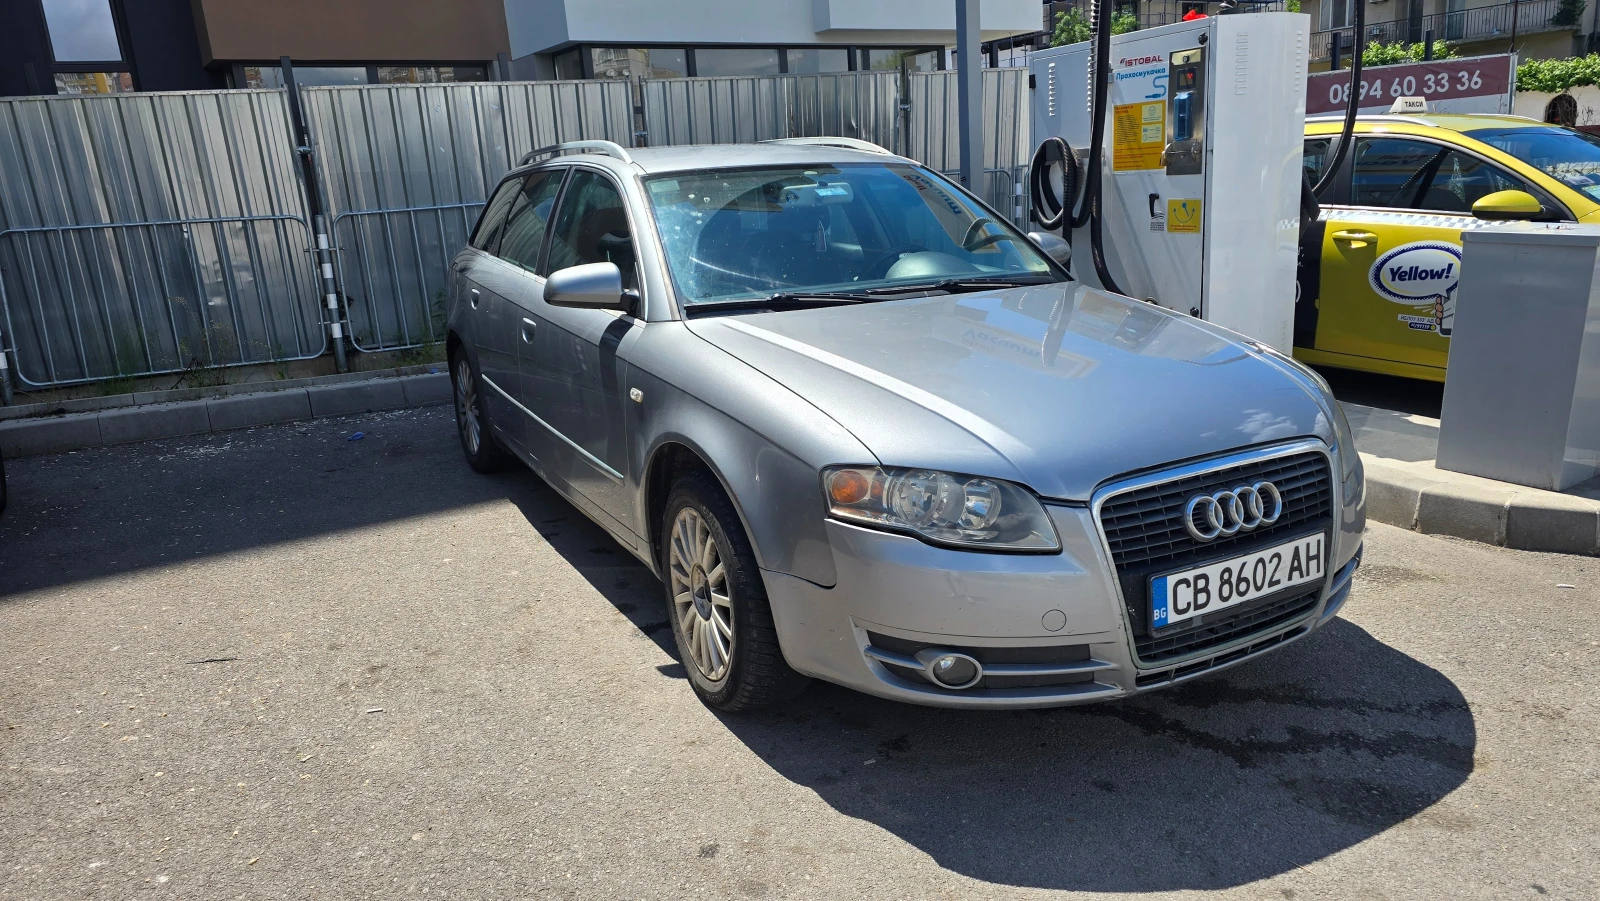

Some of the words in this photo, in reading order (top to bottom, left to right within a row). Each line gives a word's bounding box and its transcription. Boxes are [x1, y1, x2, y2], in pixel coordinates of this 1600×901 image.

[1125, 55, 1163, 67] ISTOBAL
[1116, 68, 1166, 81] Прахосмукачка
[1390, 75, 1416, 97] 60
[1423, 72, 1450, 94] 33
[1456, 70, 1483, 91] 36
[1389, 263, 1454, 282] Yellow!
[1172, 573, 1211, 615] CB
[1218, 552, 1282, 603] 8602
[1287, 539, 1321, 582] AH
[1154, 607, 1167, 620] BG
